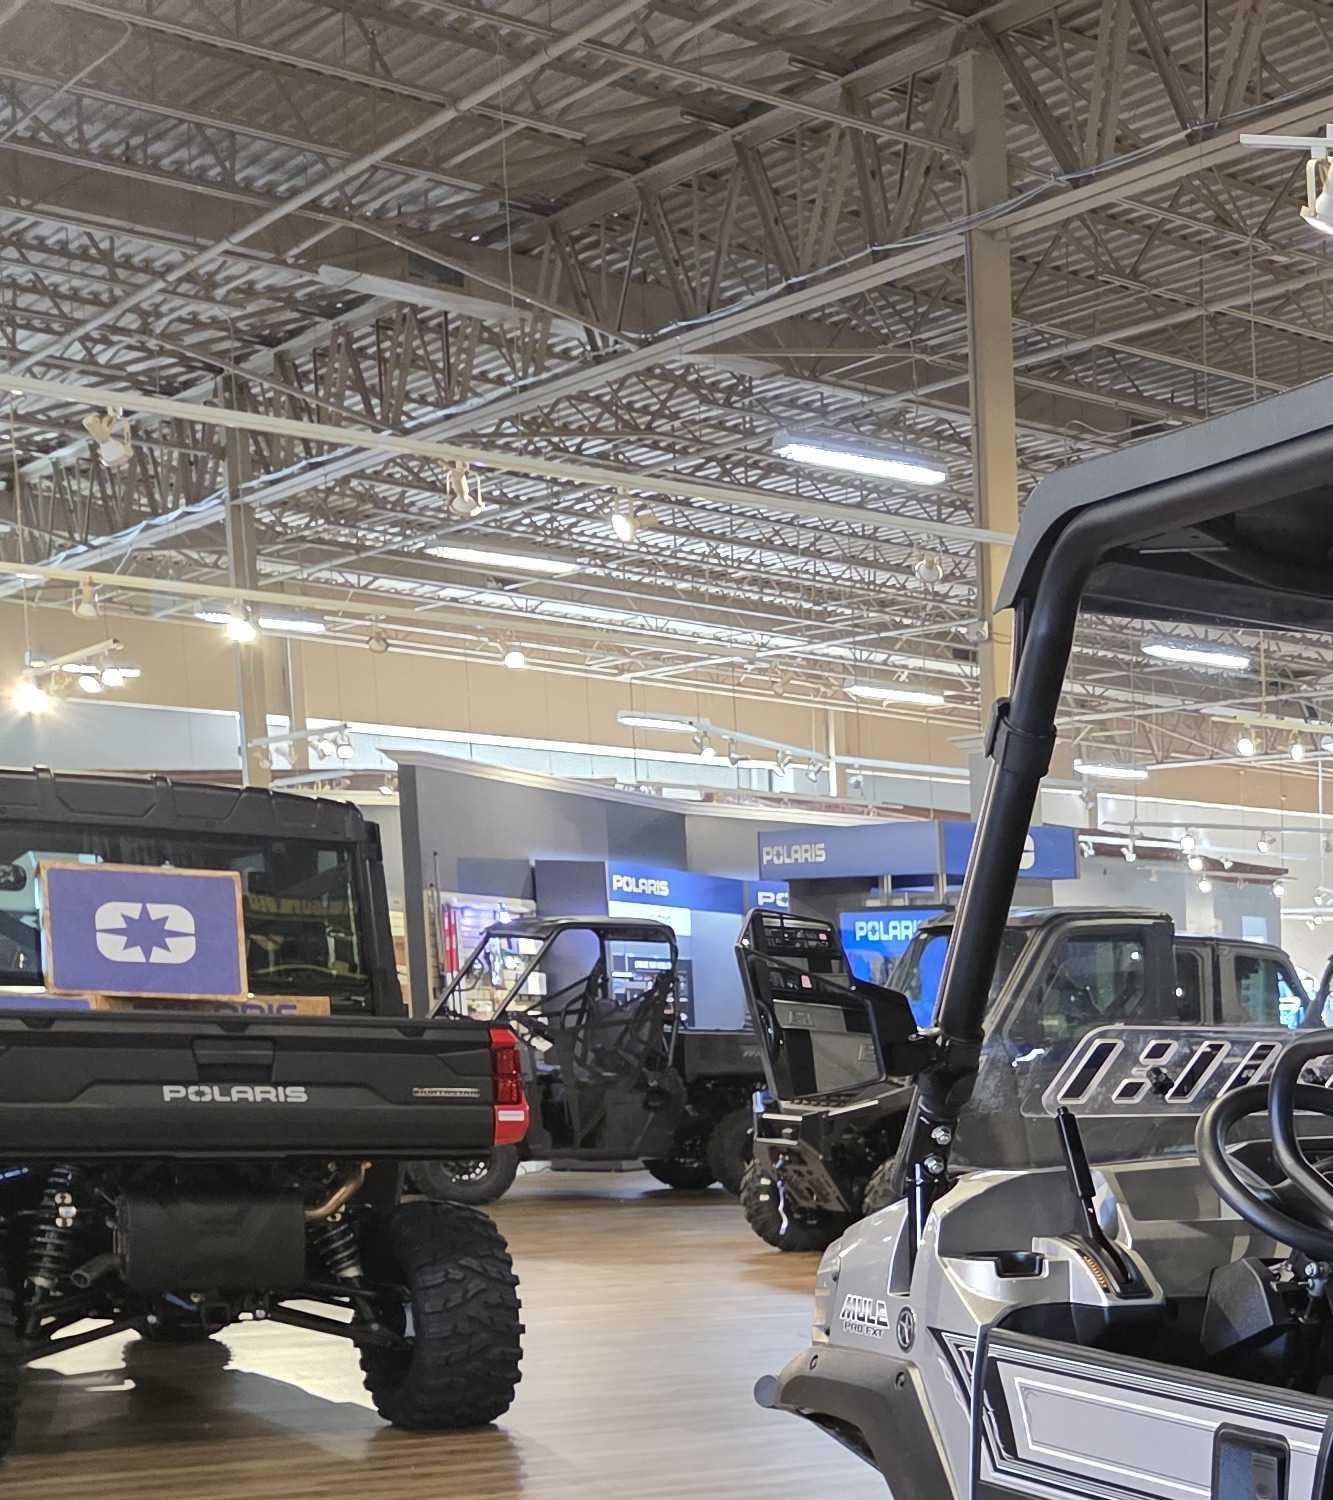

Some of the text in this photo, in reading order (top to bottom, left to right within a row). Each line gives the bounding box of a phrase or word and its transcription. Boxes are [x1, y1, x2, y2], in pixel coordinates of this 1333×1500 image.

[763, 843, 827, 865] POLARIS
[612, 874, 670, 897] POLARIS
[162, 1085, 309, 1102] POLARIS
[840, 1294, 890, 1329] MULE
[844, 1321, 863, 1335] PRO
